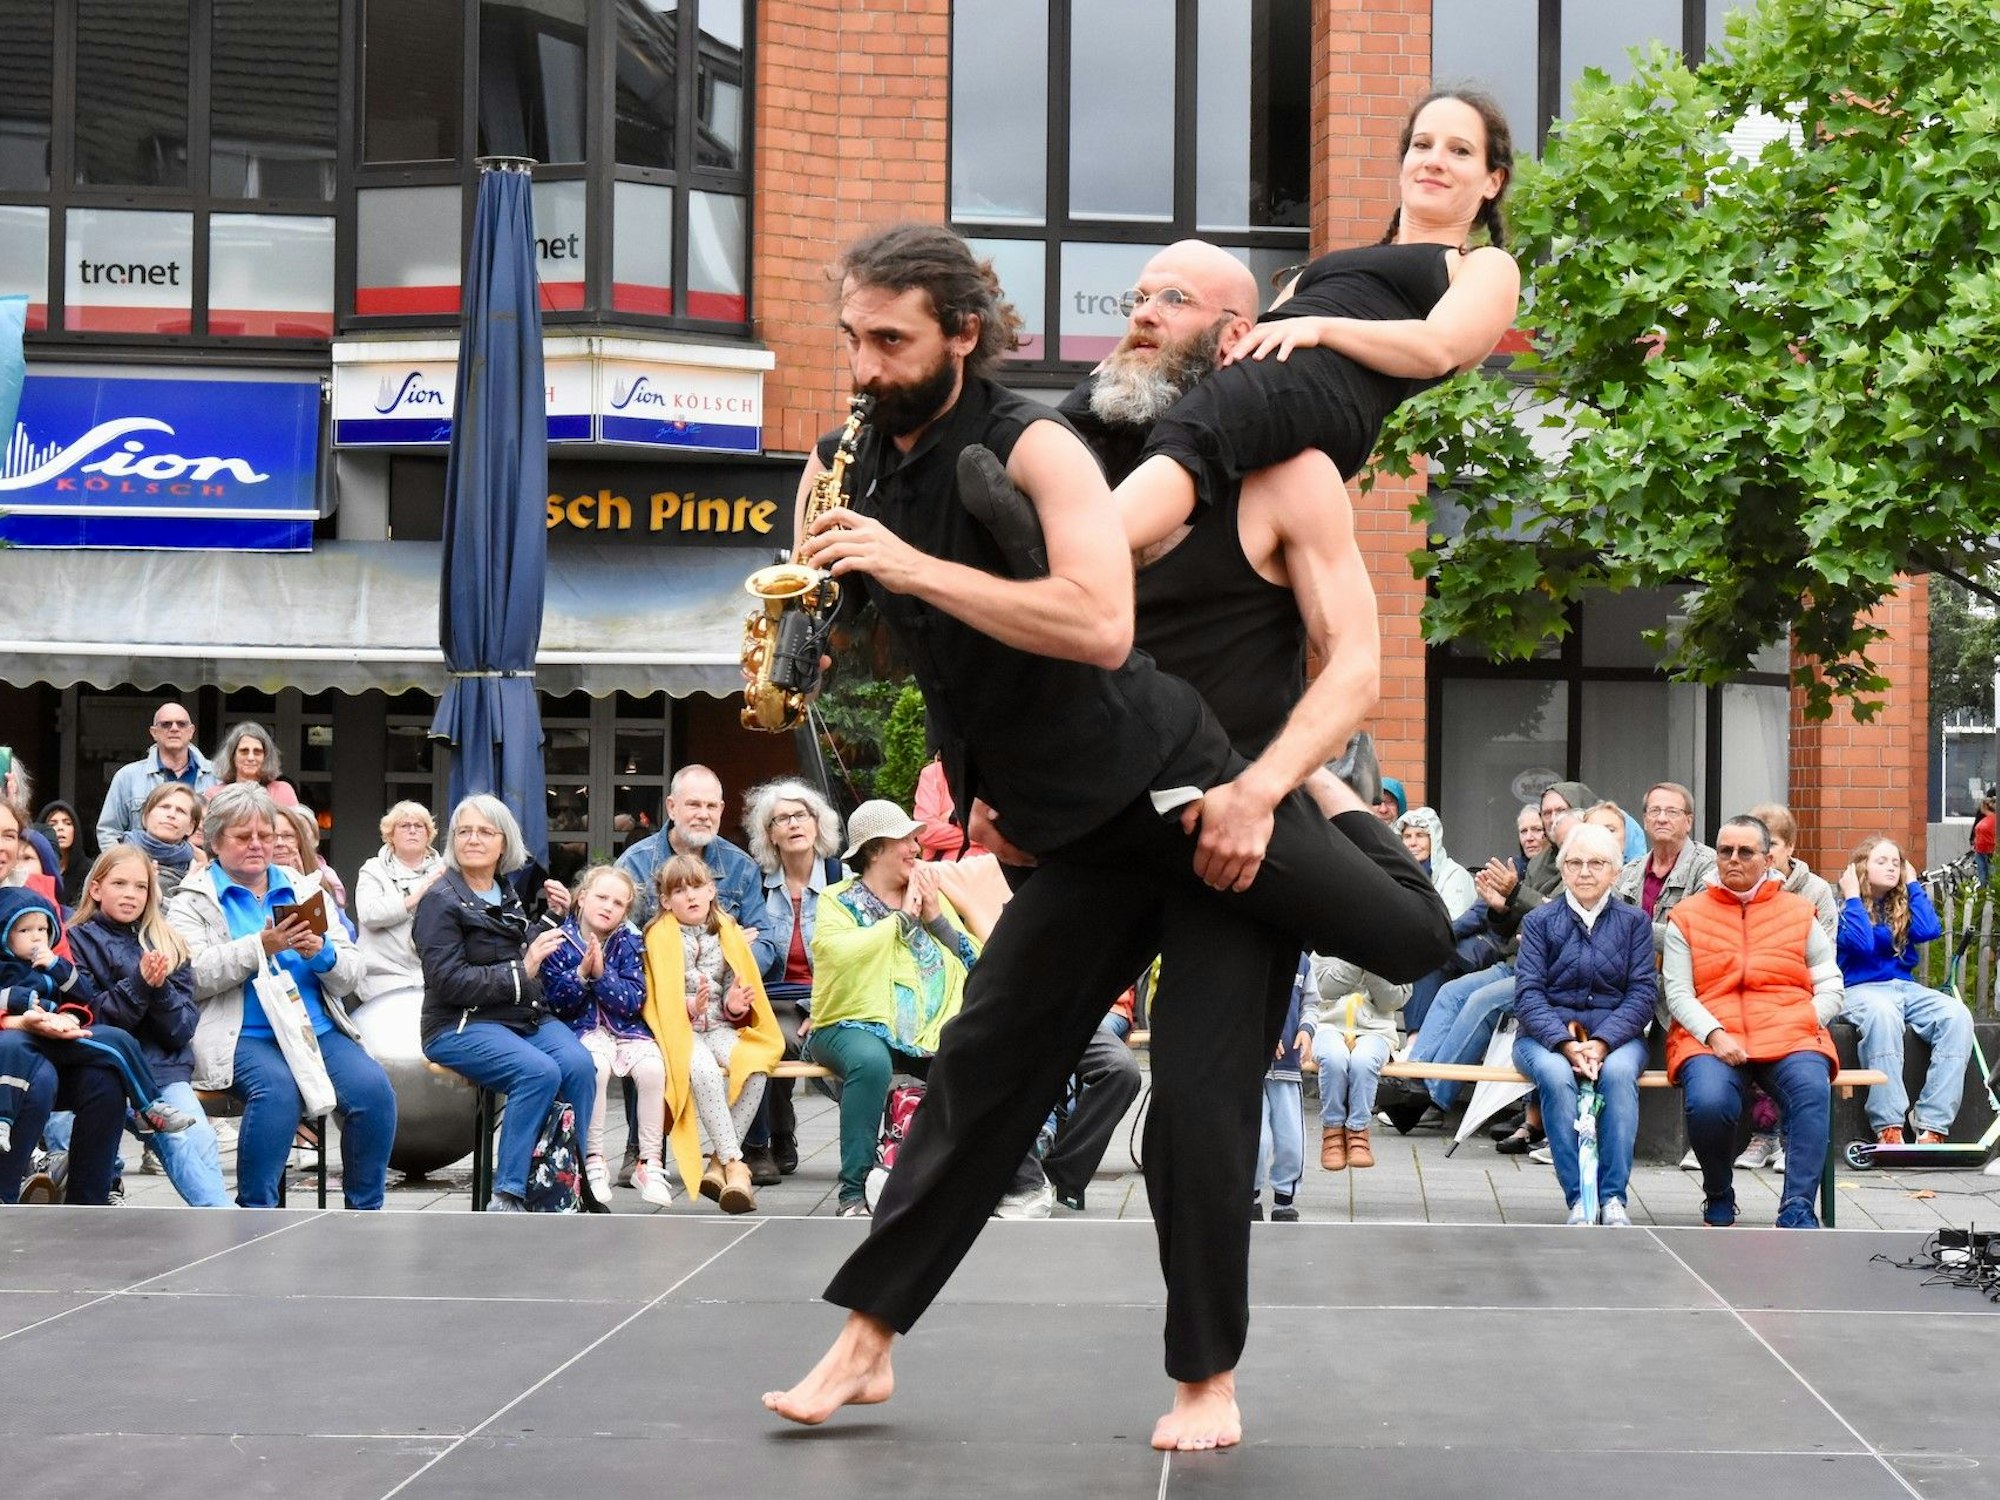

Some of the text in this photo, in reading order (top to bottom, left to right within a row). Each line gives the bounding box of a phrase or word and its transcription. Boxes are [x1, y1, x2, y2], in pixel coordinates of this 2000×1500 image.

[533, 233, 579, 259] net
[1074, 291, 1118, 315] tro
[375, 371, 445, 415] Sion
[610, 376, 753, 413] Sion KÖLSCH
[0, 417, 270, 490] Sion
[56, 476, 224, 496] KÖLSCH
[546, 489, 778, 534] sch Pinte
